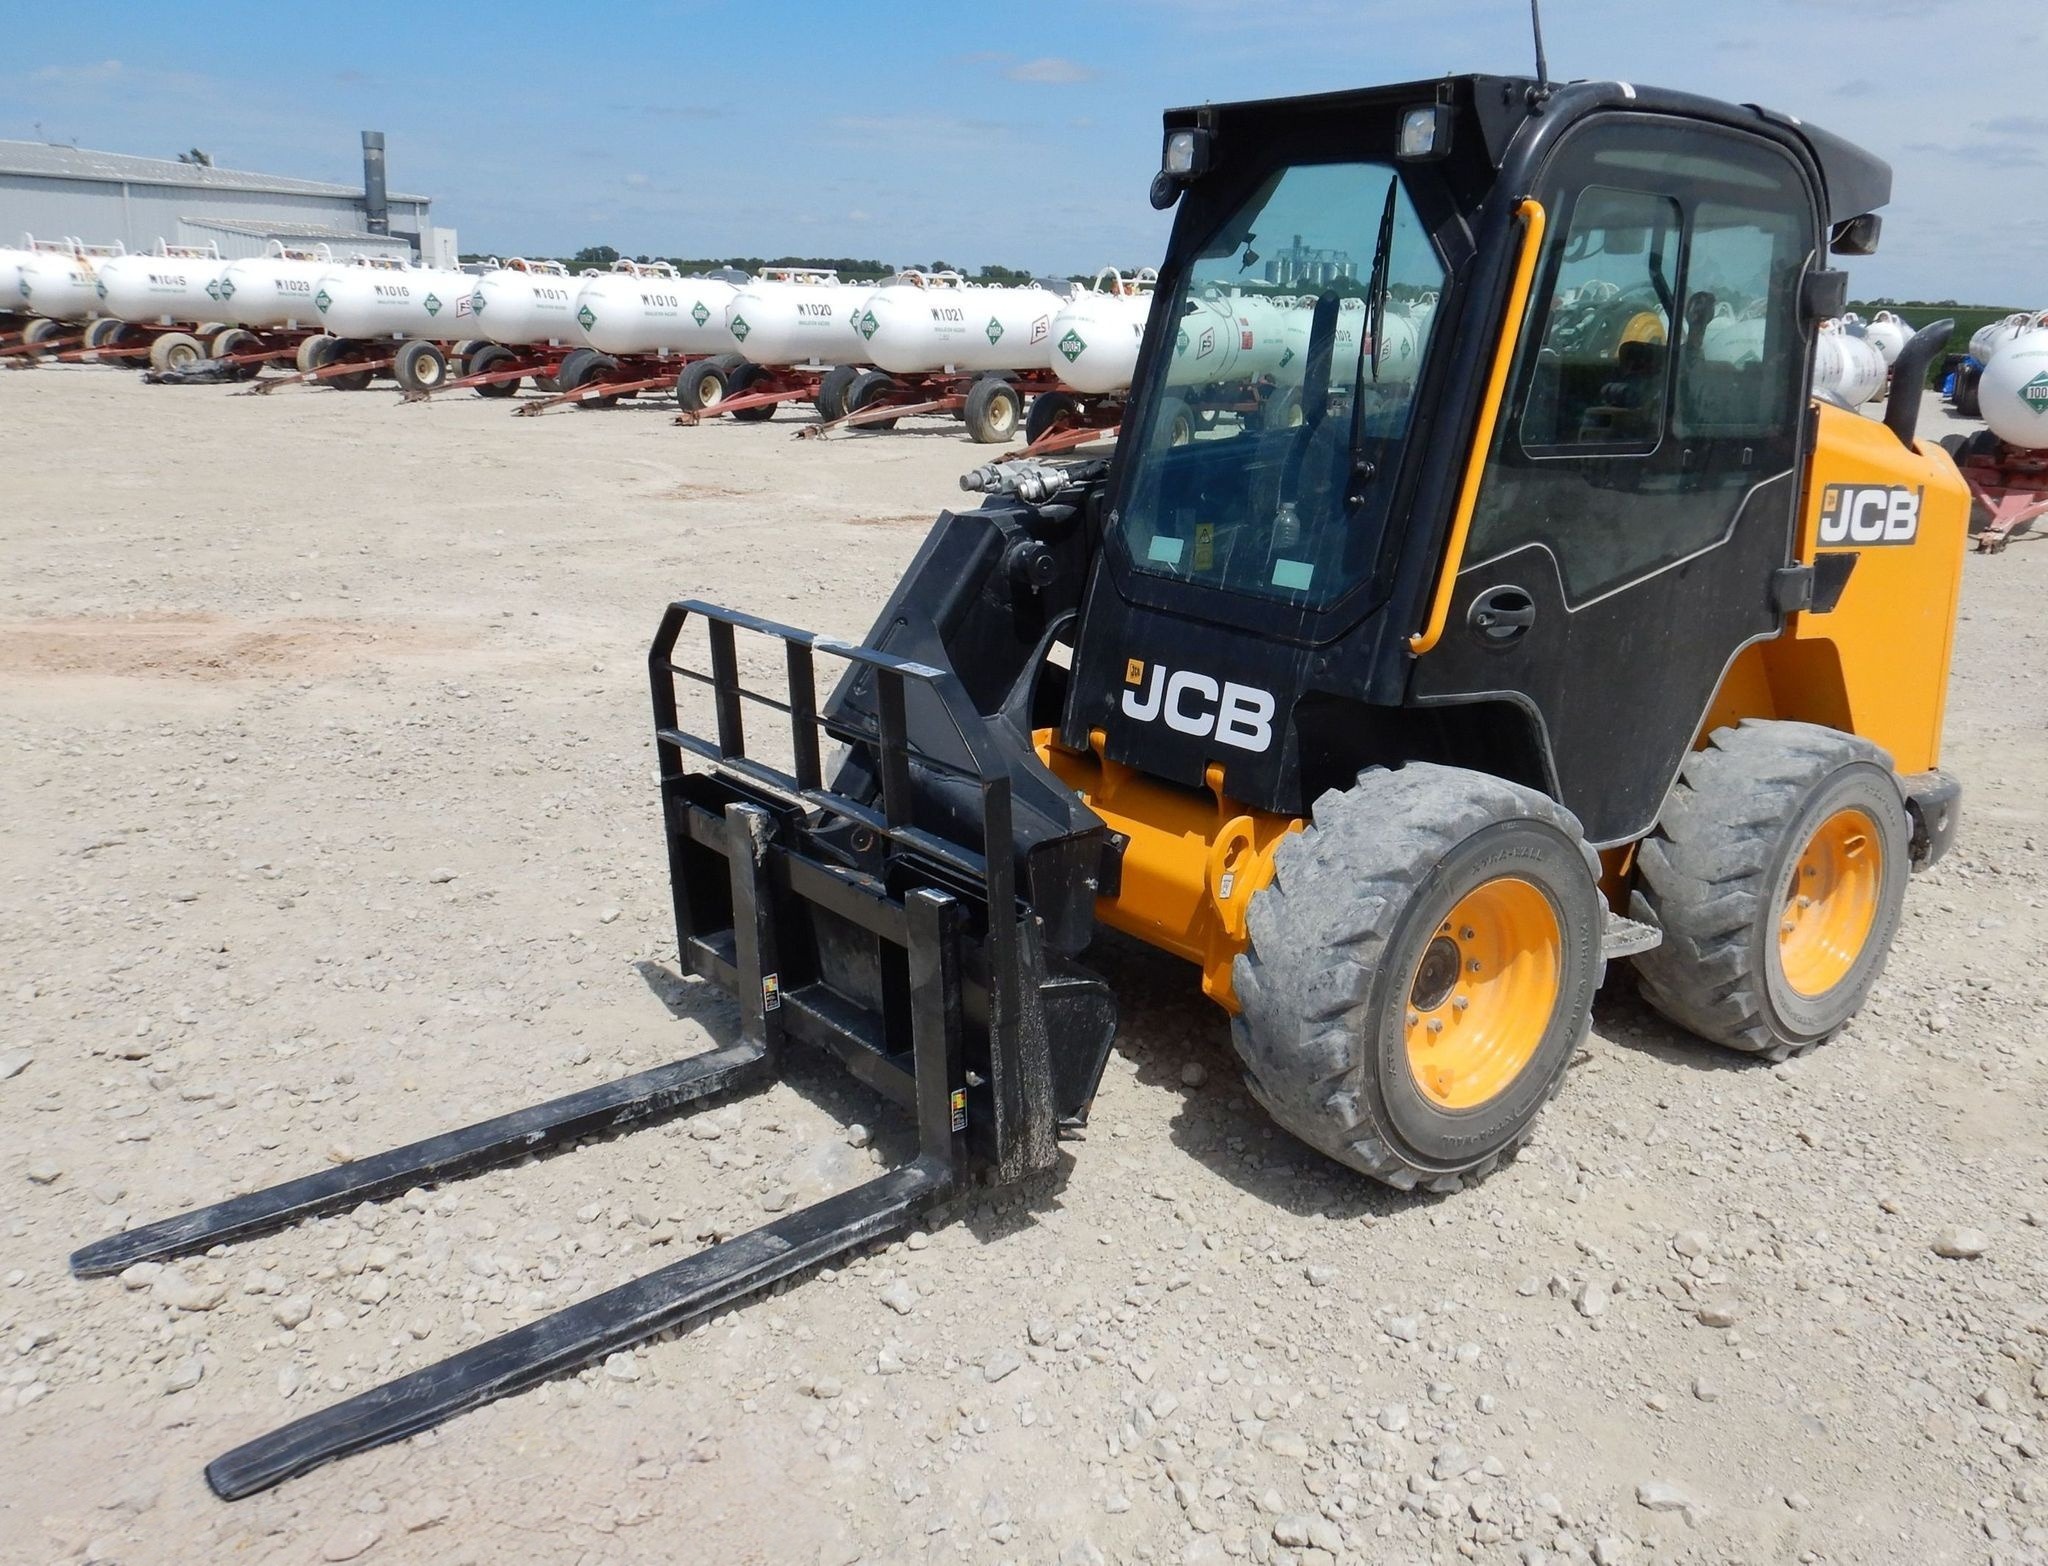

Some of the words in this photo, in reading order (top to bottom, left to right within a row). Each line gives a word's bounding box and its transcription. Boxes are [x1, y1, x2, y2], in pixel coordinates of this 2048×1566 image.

[275, 279, 310, 291] W1023
[532, 288, 568, 300] W1017
[640, 294, 678, 308] W1010
[797, 303, 832, 317] W1020
[931, 307, 964, 321] W1021
[1035, 321, 1047, 337] FS
[1820, 489, 1920, 542] JCB
[1121, 664, 1276, 753] JCB
